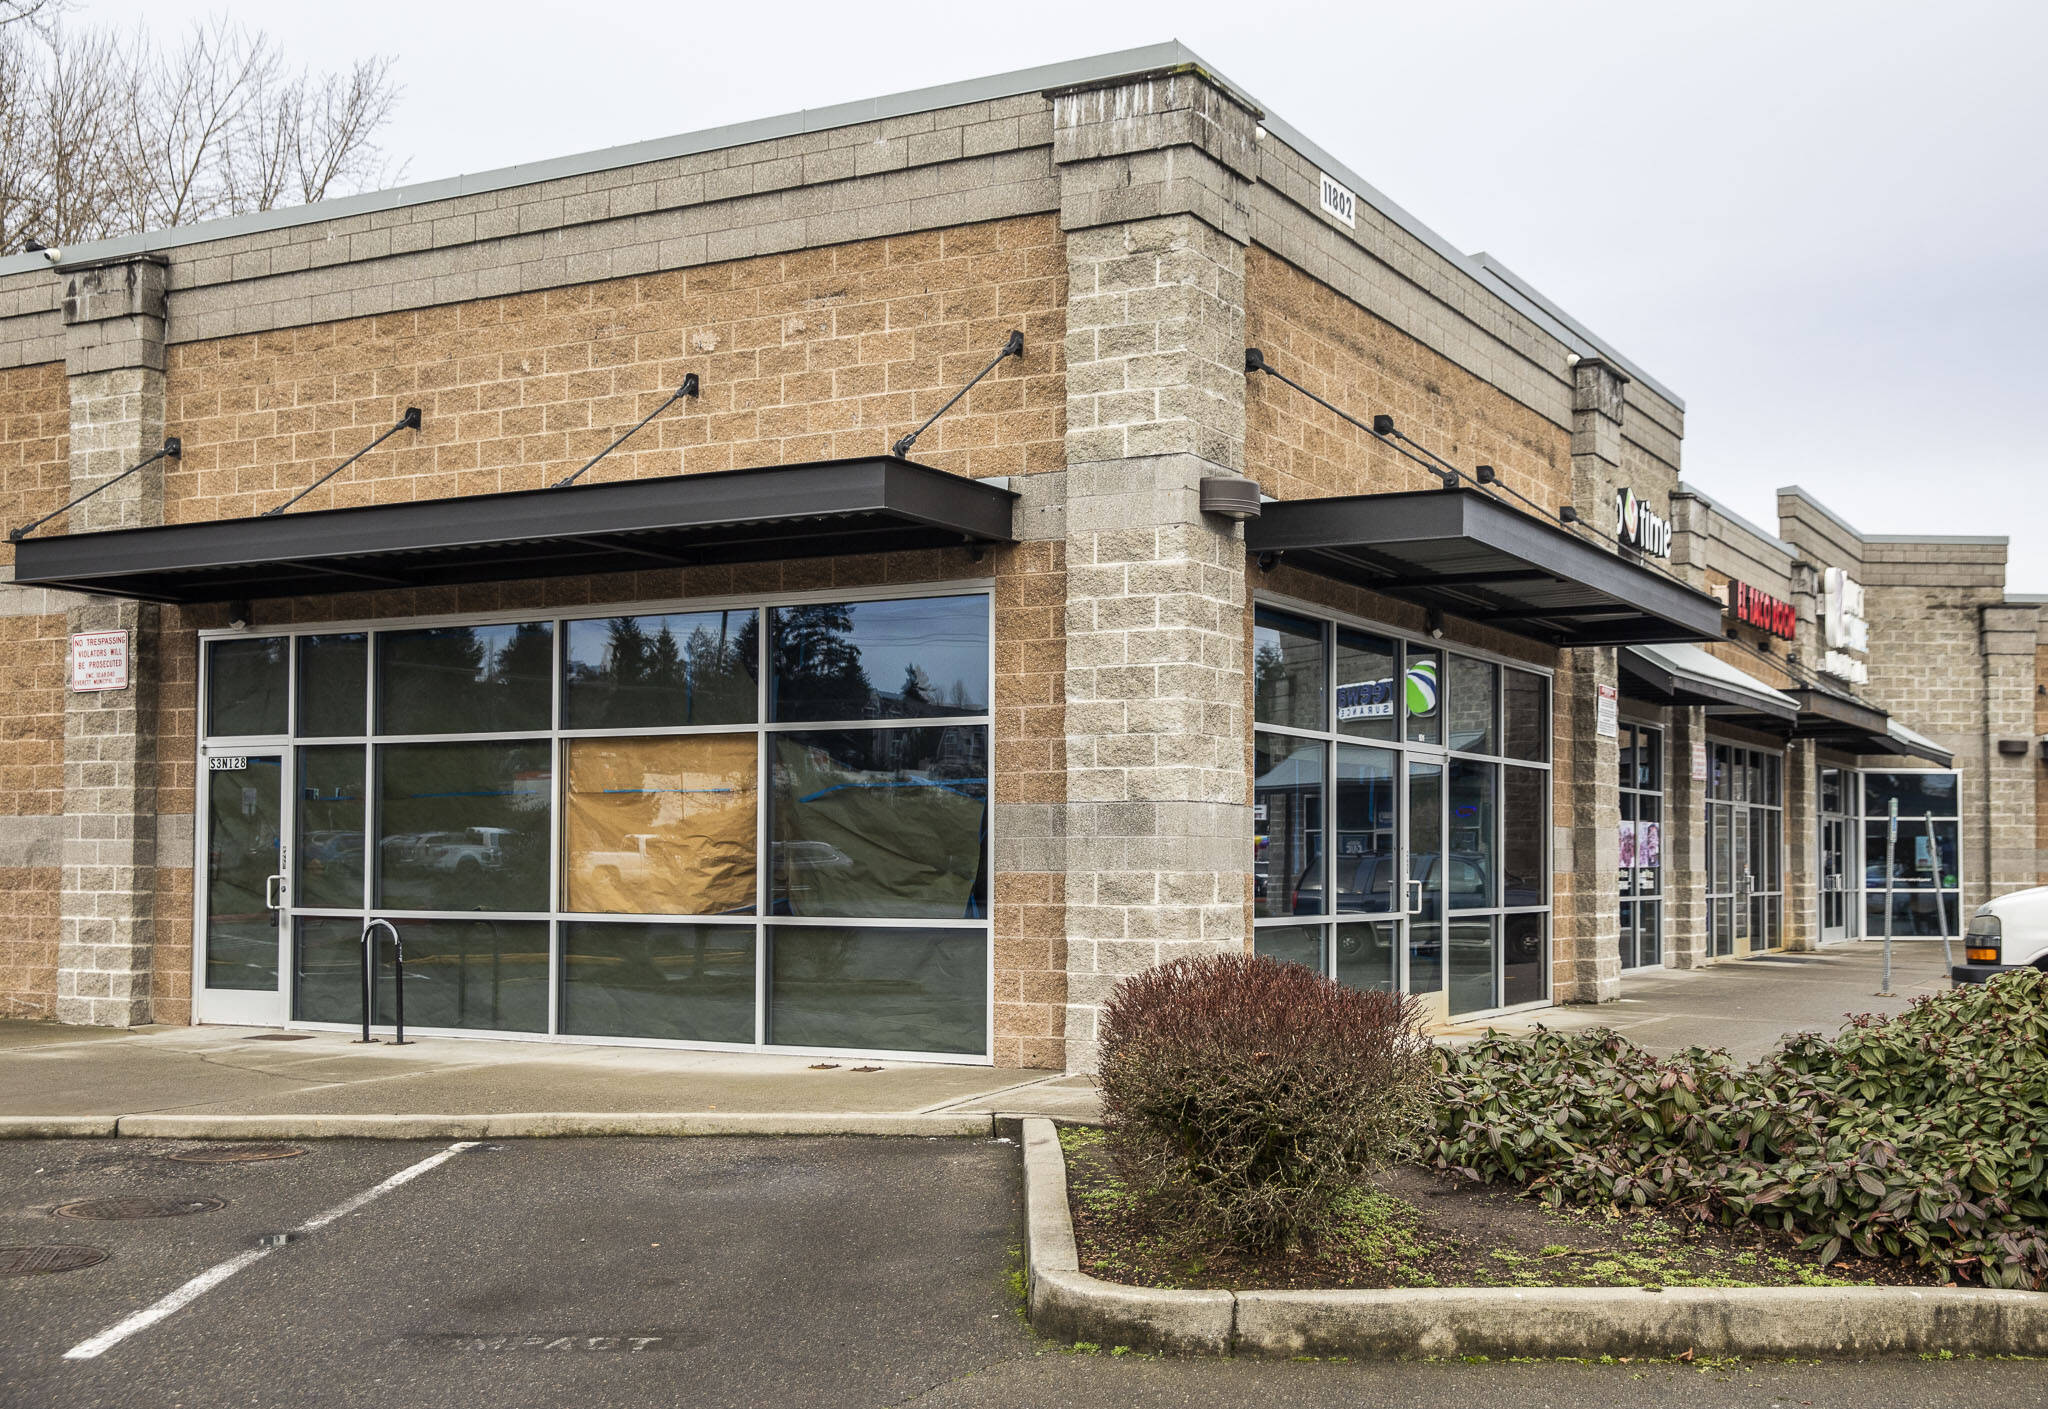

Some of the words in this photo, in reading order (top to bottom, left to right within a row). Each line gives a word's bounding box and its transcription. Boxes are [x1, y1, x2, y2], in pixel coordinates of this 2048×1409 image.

[1323, 180, 1352, 220] 11802
[1639, 500, 1672, 558] time
[86, 636, 126, 646] TRESPASSING
[78, 649, 107, 658] VIOLATORS
[110, 648, 122, 656] WILL
[78, 662, 86, 670] BE
[88, 660, 122, 669] PROSECUTED
